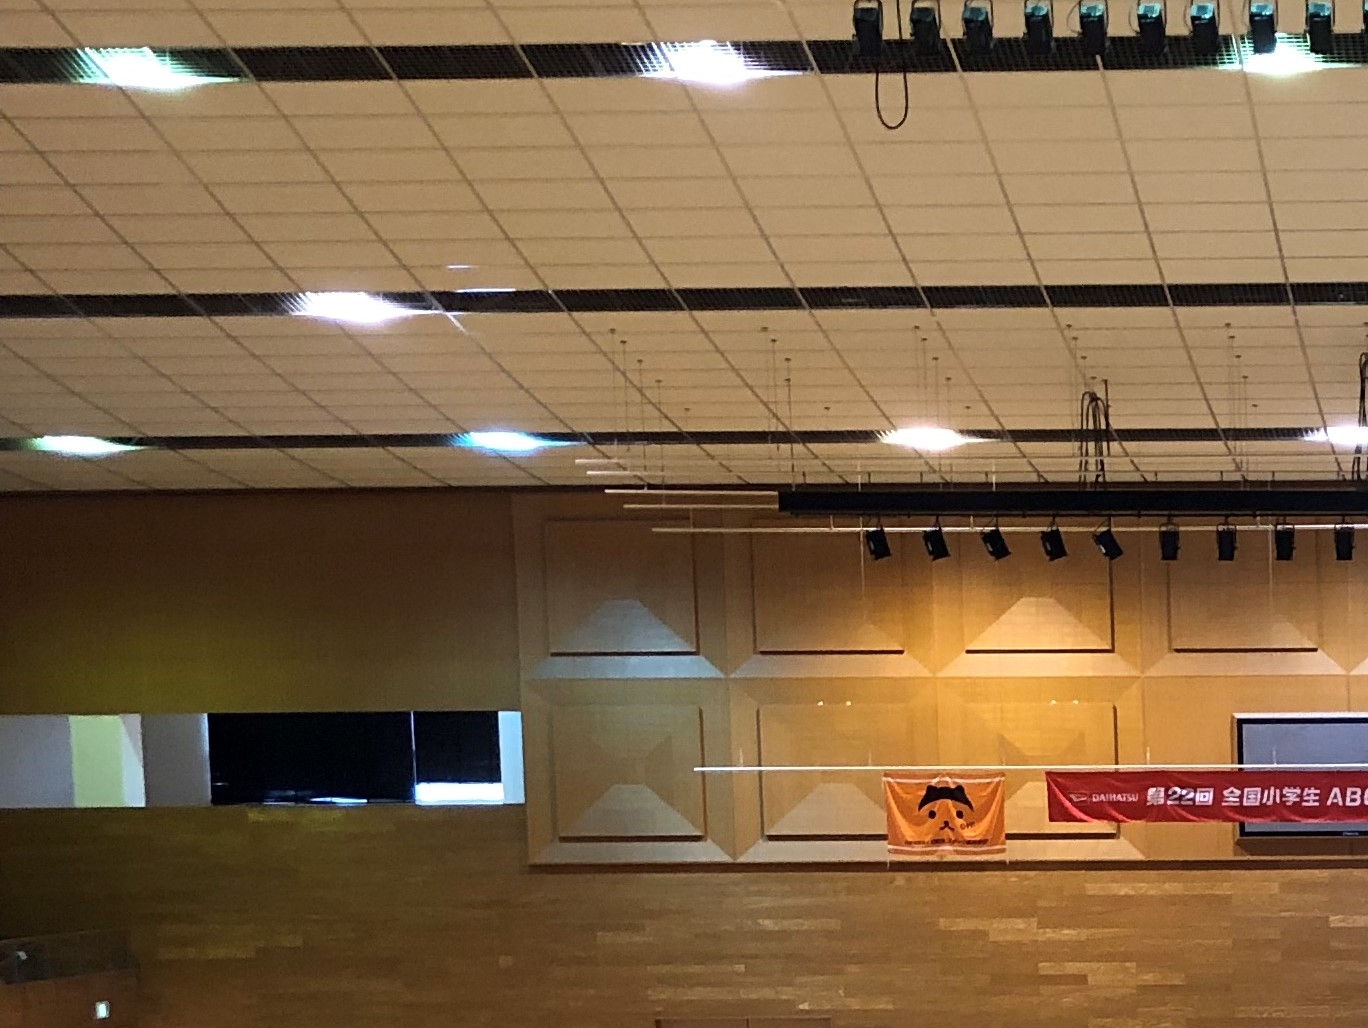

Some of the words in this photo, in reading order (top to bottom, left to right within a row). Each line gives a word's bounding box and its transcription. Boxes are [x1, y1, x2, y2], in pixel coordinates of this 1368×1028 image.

[1092, 793, 1139, 802] DAIHATSU
[1146, 786, 1214, 806] 第22回
[1221, 786, 1321, 806] 全国小学生
